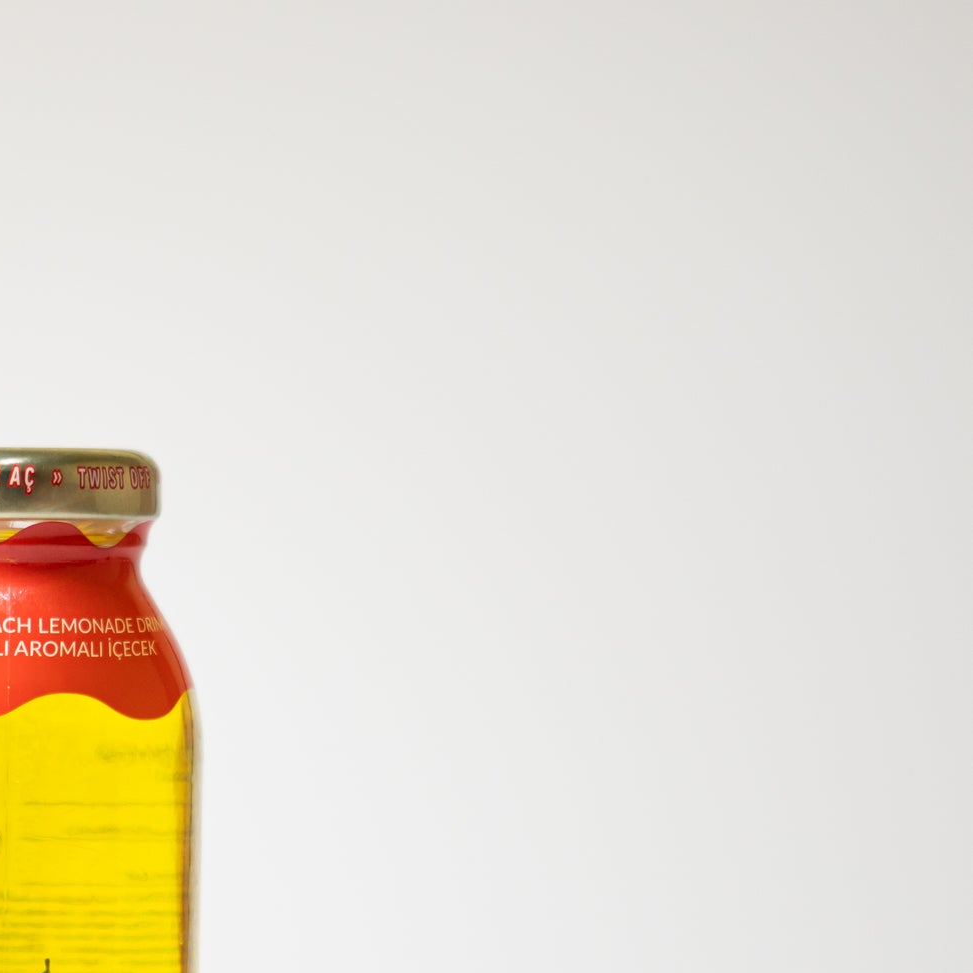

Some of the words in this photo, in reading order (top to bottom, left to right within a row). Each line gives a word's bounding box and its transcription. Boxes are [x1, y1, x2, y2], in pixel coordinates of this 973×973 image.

[7, 464, 36, 495] AÇ
[78, 465, 125, 490] TWIST
[129, 466, 151, 489] OFF
[38, 617, 135, 634] LEMONADE
[136, 616, 165, 633] DRIN
[14, 639, 103, 657] AROMALI
[108, 637, 157, 660] İÇECEK
